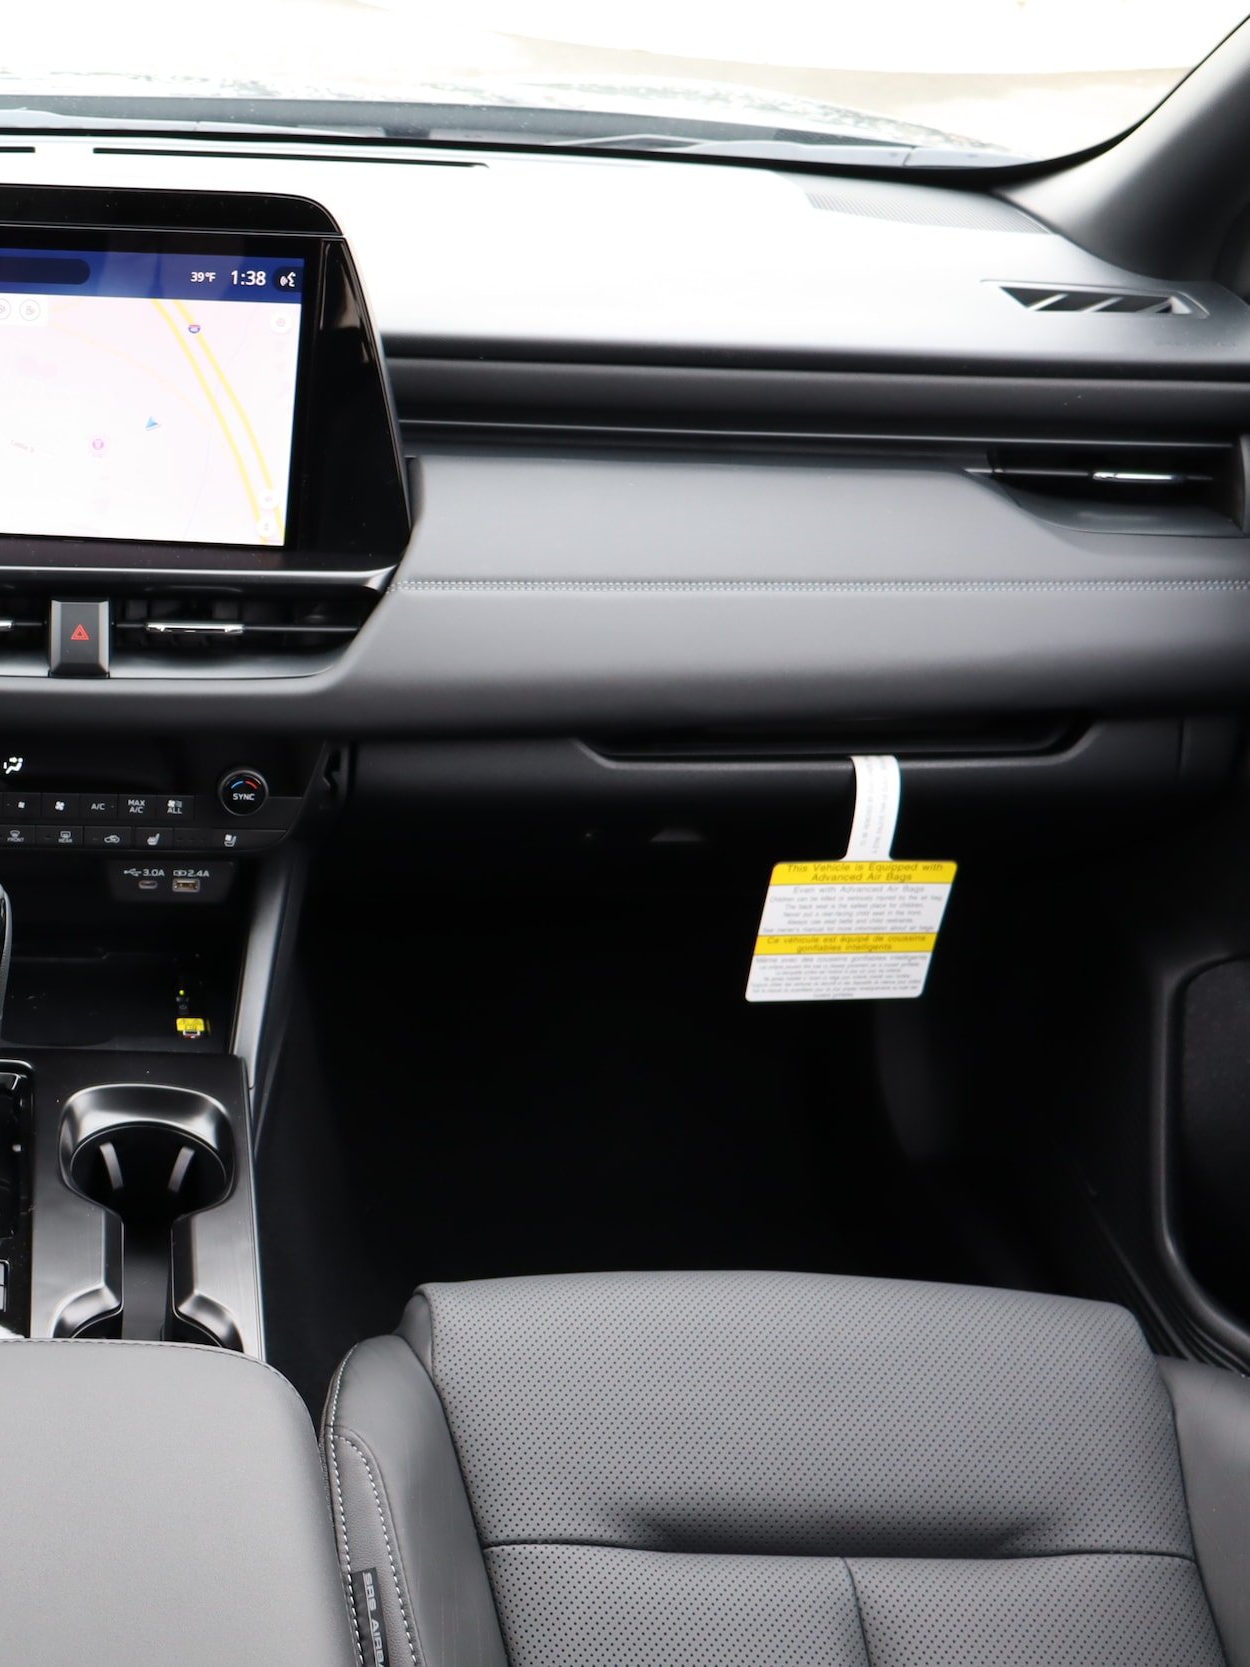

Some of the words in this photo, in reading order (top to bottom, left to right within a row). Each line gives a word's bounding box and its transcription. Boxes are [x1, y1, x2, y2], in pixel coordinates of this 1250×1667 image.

[190, 272, 216, 282] 39°F
[231, 270, 266, 286] 1:38
[233, 793, 255, 801] SYNC
[91, 803, 105, 811] A/C
[788, 864, 808, 872] This
[813, 863, 850, 872] Vehicle
[855, 863, 863, 871] is
[868, 863, 918, 872] Equipped
[922, 863, 943, 871] with
[143, 869, 164, 877] 3.0A
[811, 873, 863, 881] Advanced
[886, 872, 912, 883] Bags
[363, 1572, 377, 1612] SRS
